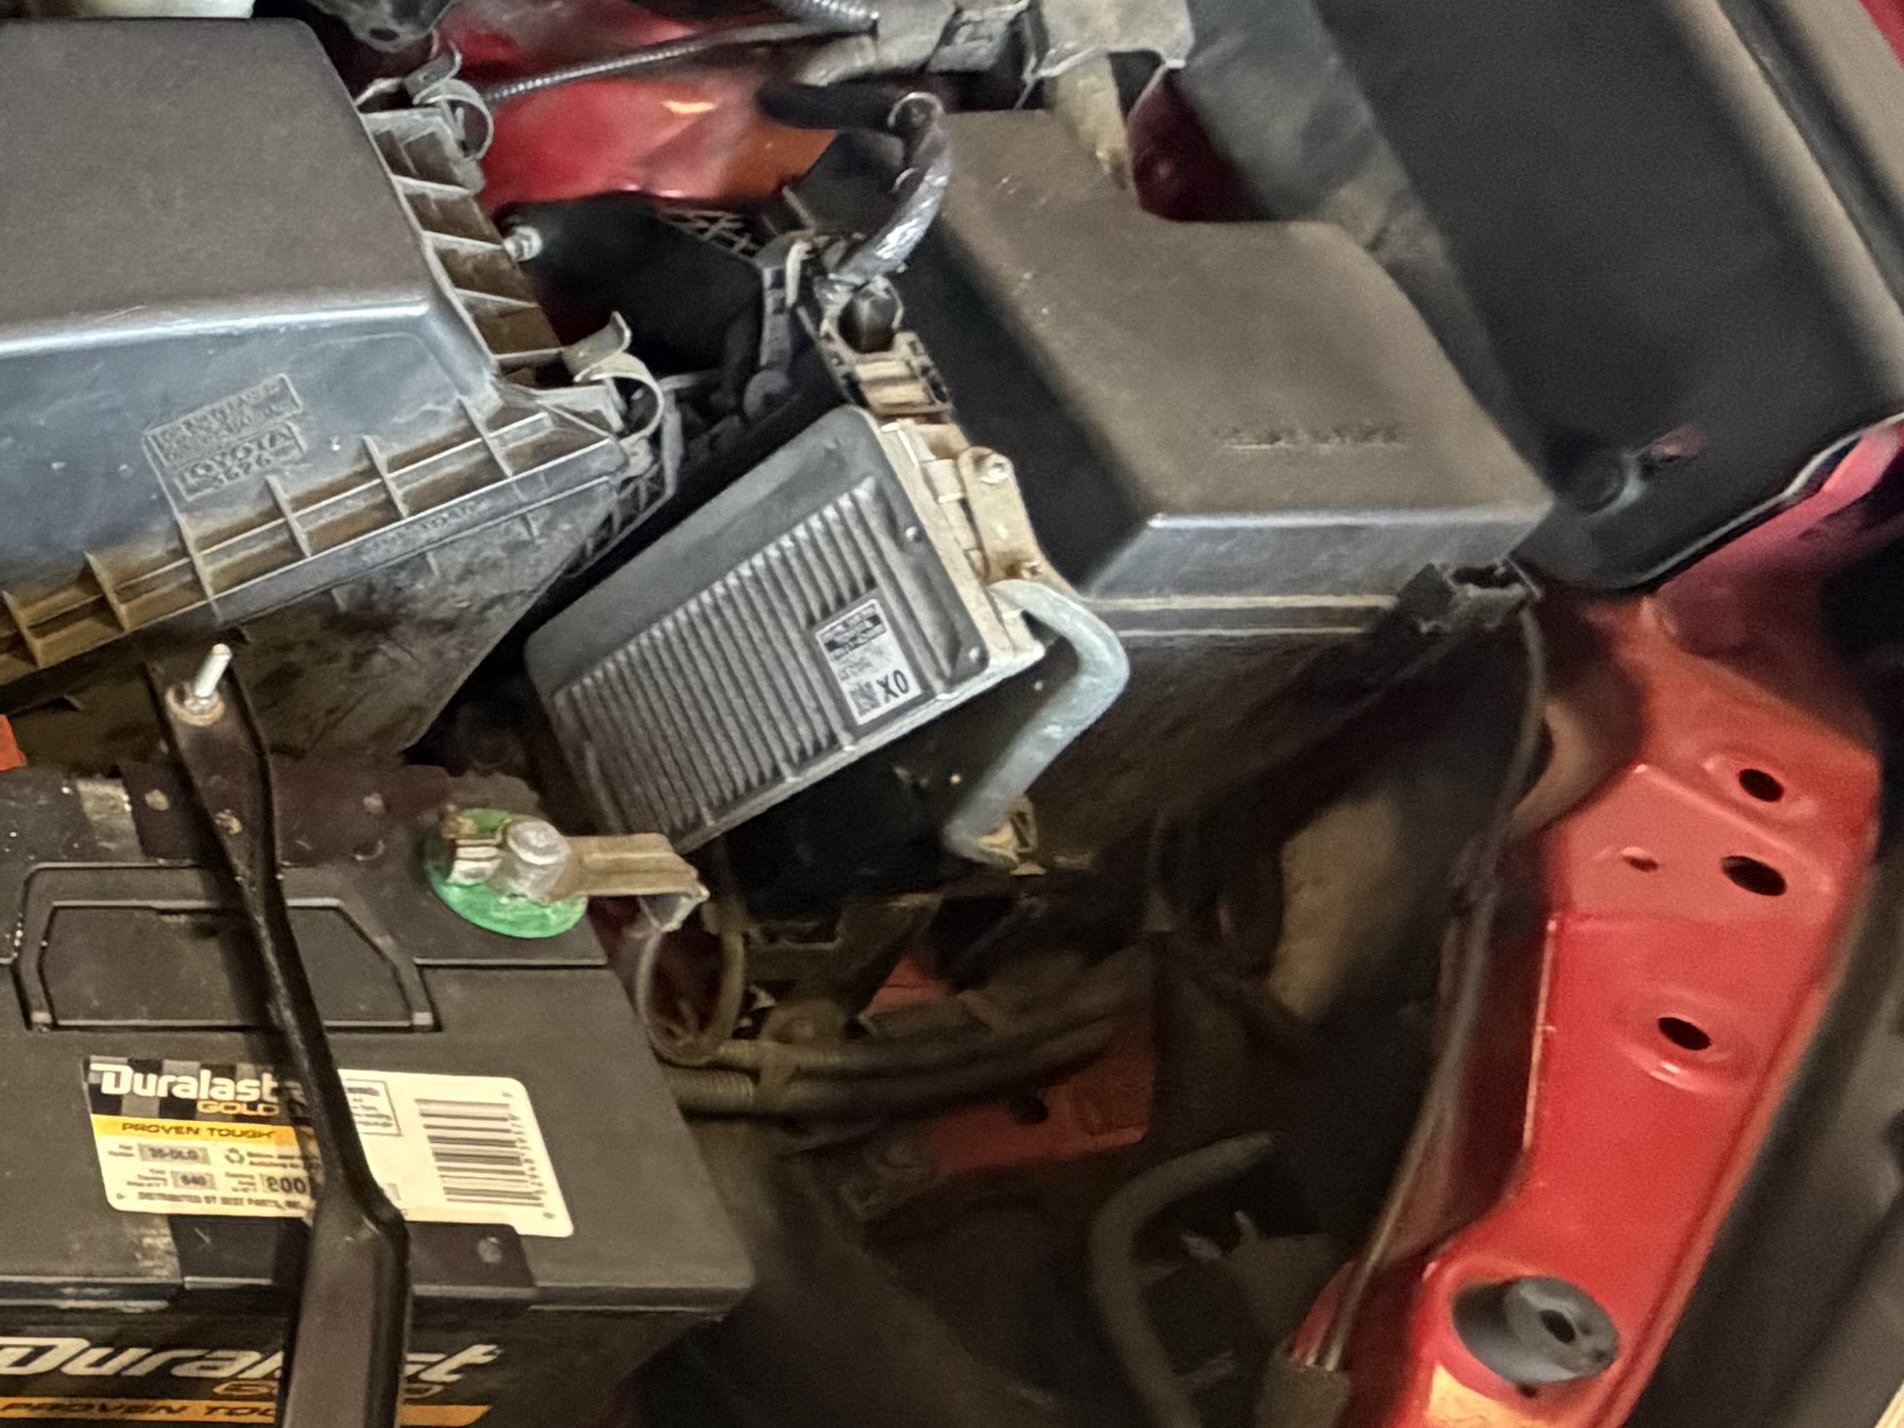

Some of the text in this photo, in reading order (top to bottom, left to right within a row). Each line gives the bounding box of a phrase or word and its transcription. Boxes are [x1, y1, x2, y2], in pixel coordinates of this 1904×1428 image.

[90, 1062, 279, 1103] Duralast
[197, 1101, 280, 1117] GOLD
[122, 1122, 276, 1139] PROVEN TOUGH
[0, 1401, 188, 1415] PROVEN
